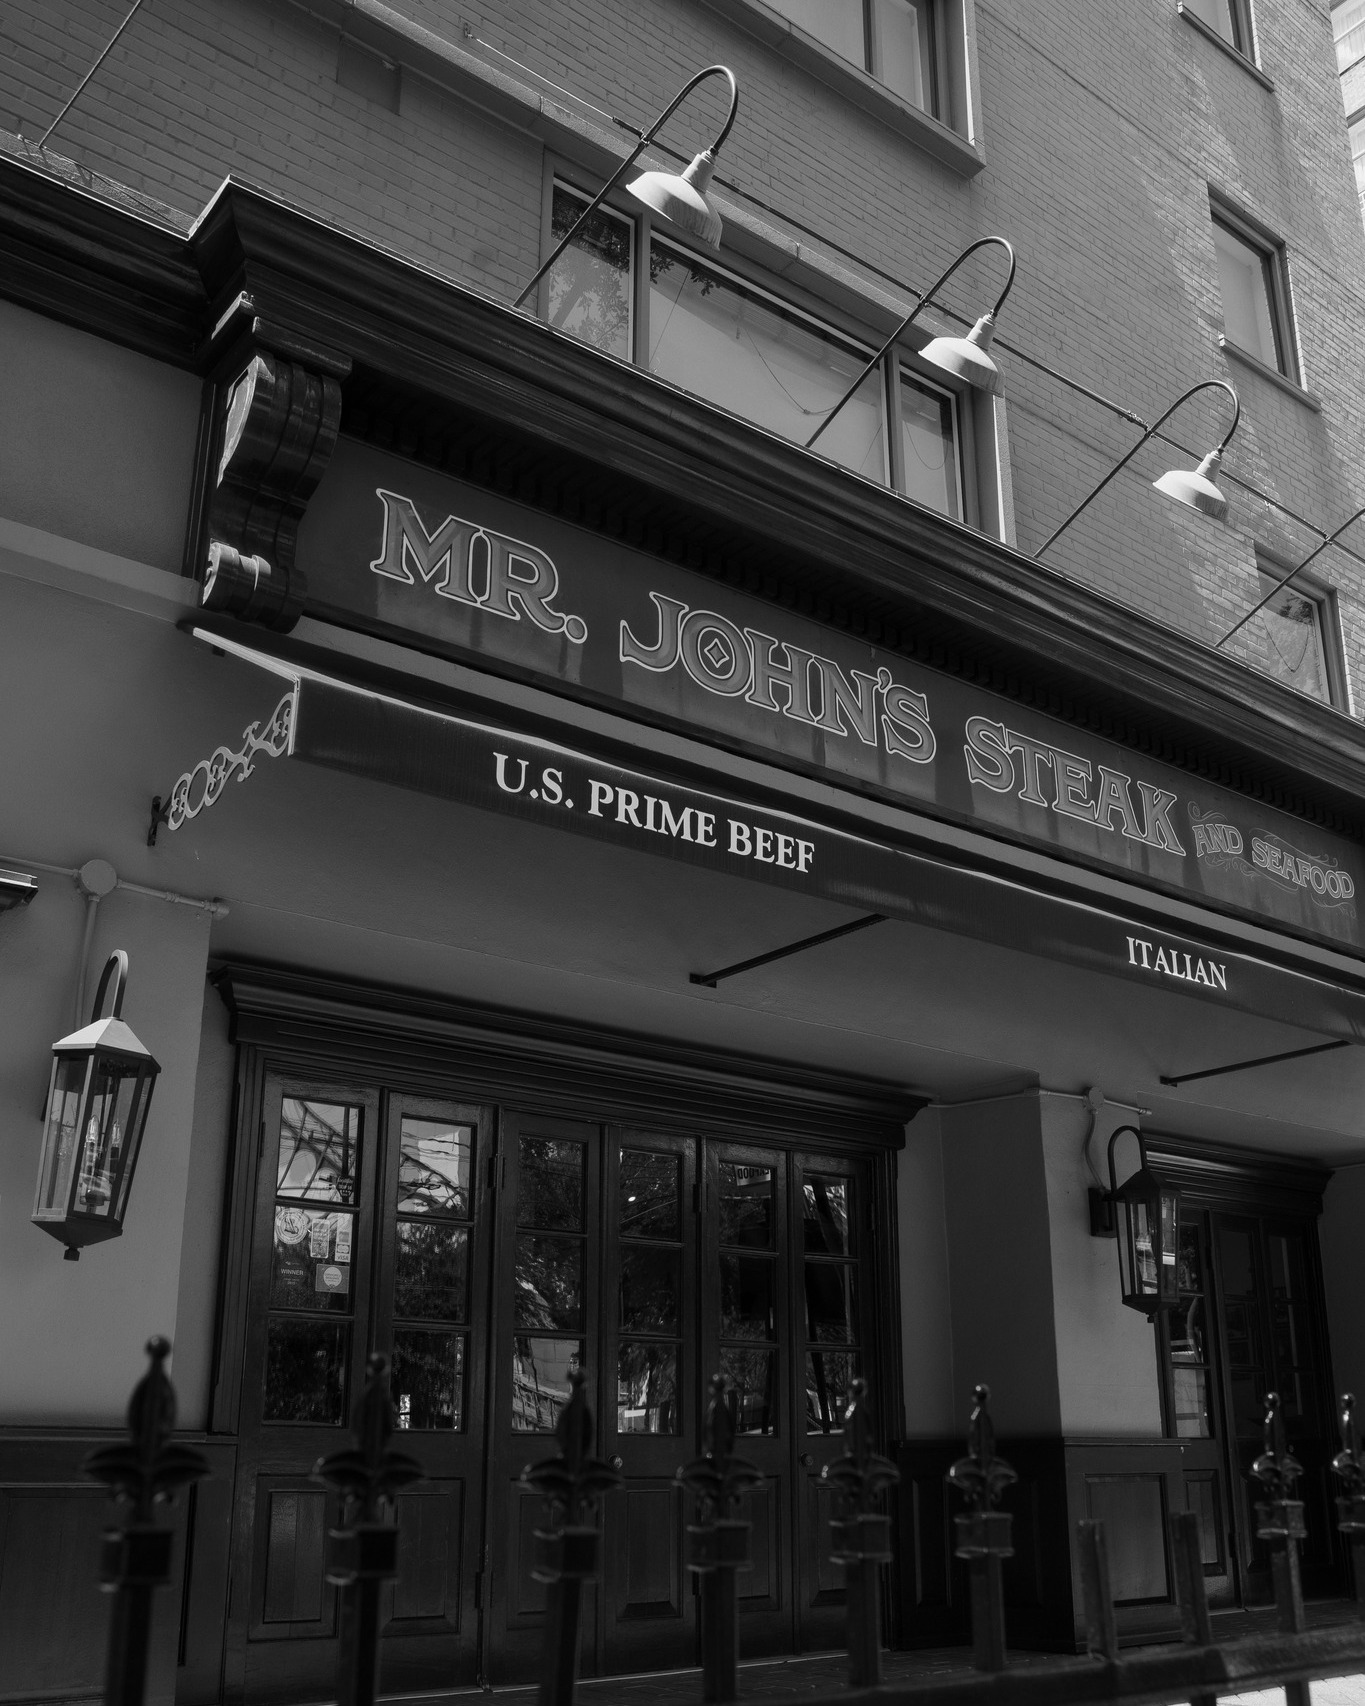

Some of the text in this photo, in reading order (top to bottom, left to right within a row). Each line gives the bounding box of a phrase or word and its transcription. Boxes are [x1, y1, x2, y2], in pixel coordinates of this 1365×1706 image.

[370, 488, 1355, 899] MR. JOHN'S STEAK AND SEAFOOD
[493, 752, 815, 873] U.S. PRIME BEEF
[1126, 936, 1227, 990] ITALIAN
[280, 1268, 304, 1276] WINNER
